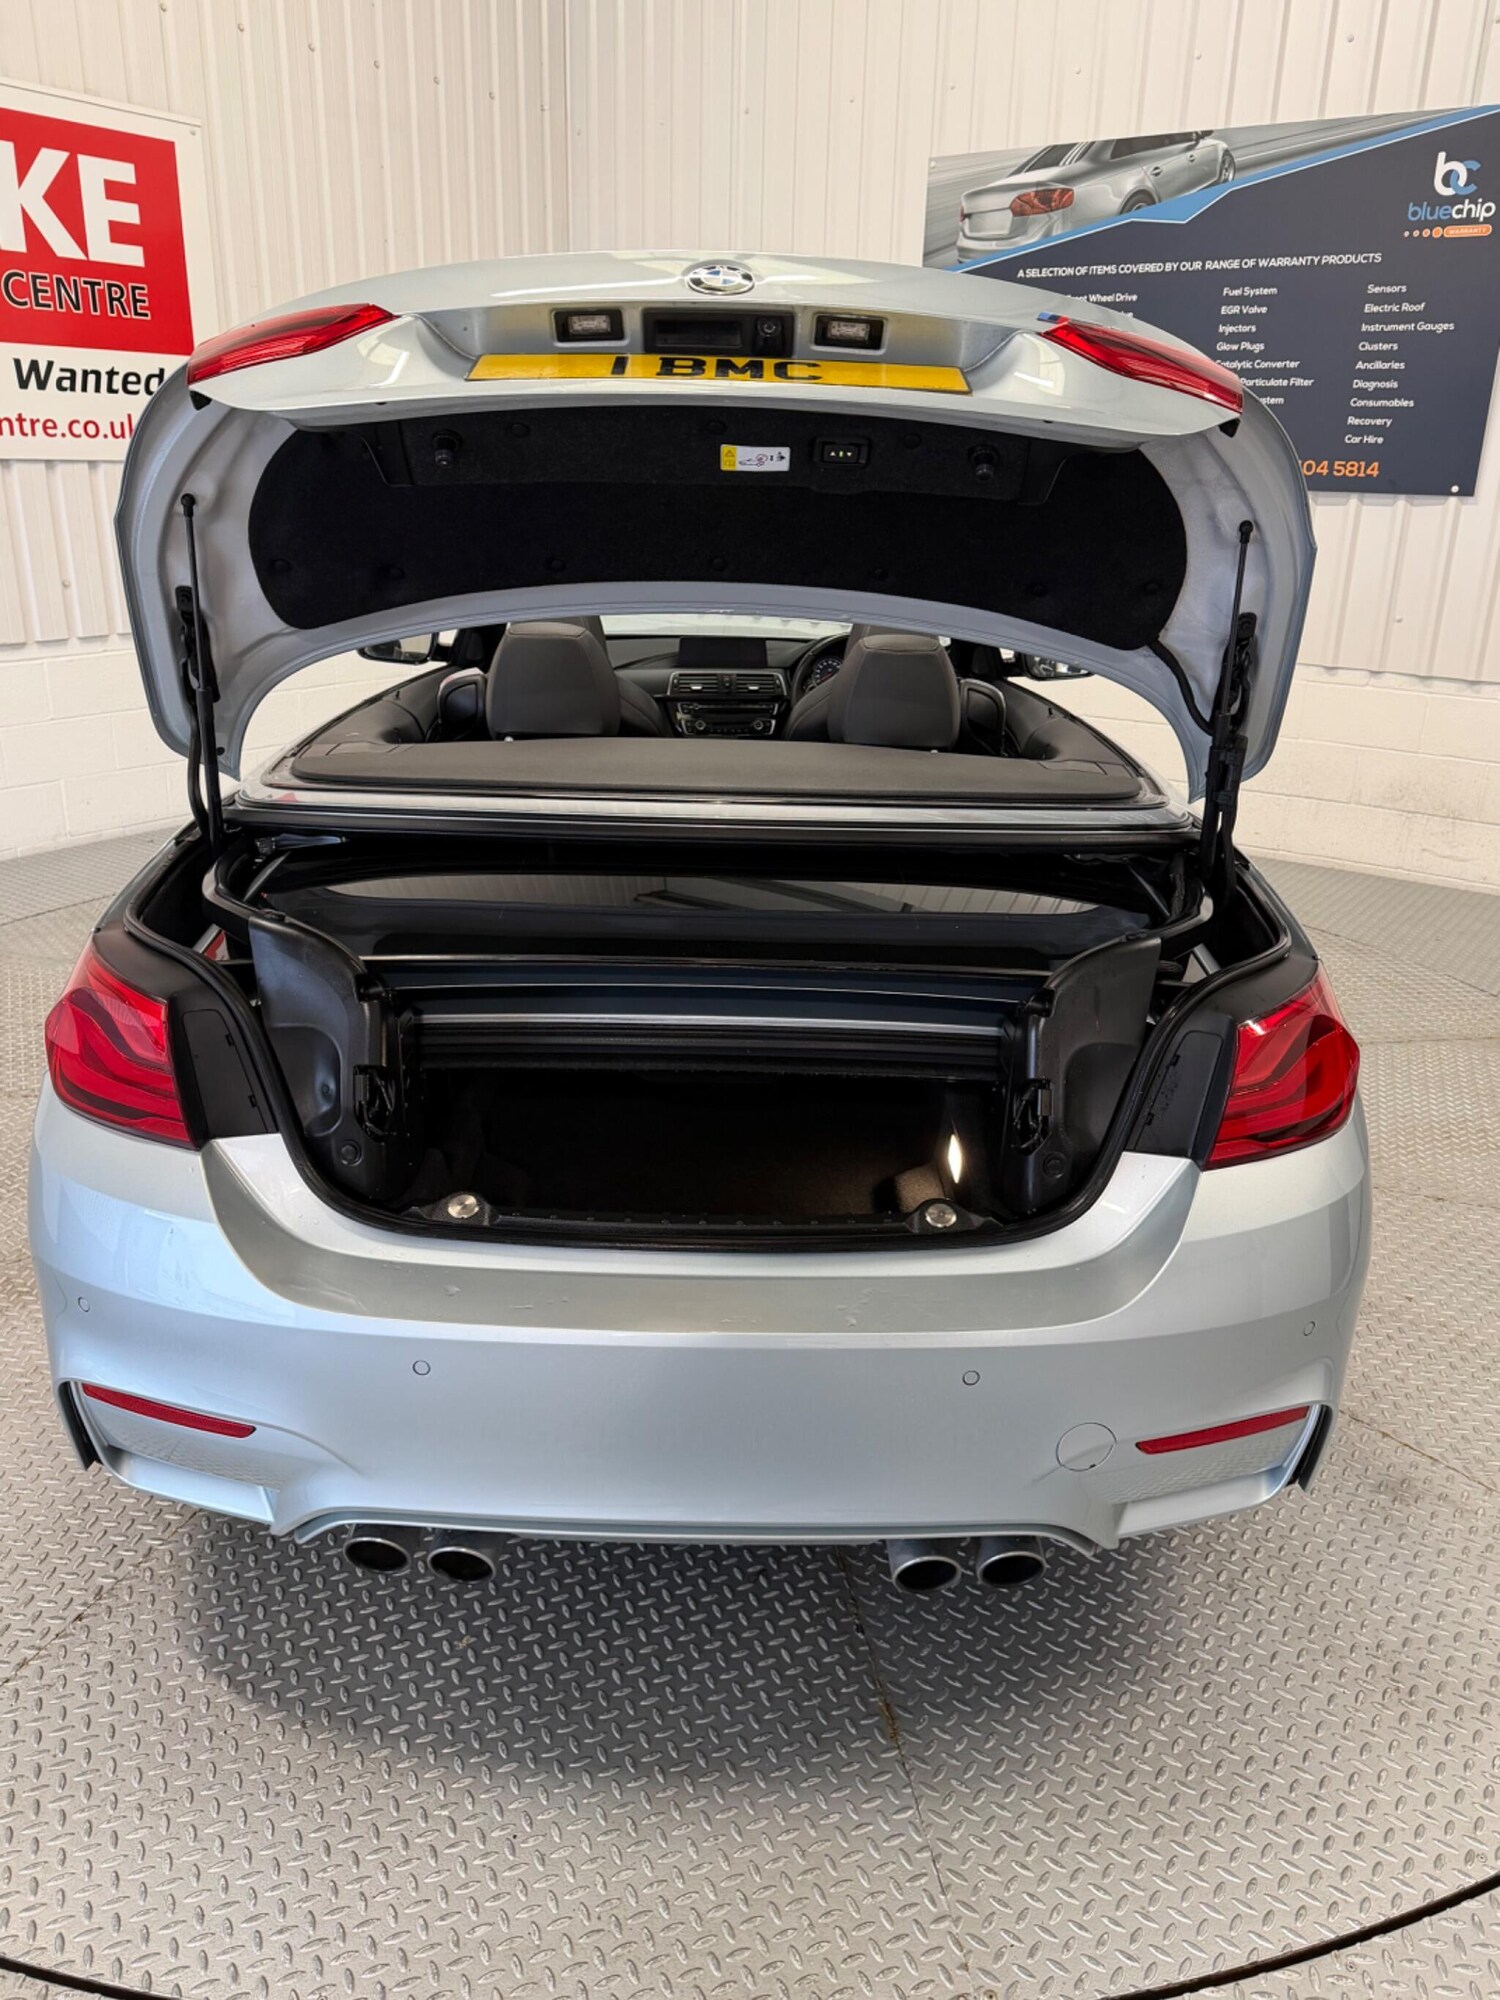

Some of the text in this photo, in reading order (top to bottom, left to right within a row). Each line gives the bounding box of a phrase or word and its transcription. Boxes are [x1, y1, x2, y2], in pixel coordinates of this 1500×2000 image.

[1408, 198, 1496, 222] bluechip
[1017, 253, 1382, 278] A SELECTION OF ITEMS COVERED BY OUR RANGE OF WARRANTY PRODUCTS
[1222, 286, 1278, 298] Fuel System
[1367, 284, 1407, 294] Sensors
[2, 271, 151, 320] CENTRE
[1088, 294, 1115, 302] Wheel
[1115, 292, 1138, 302] Drive
[1220, 304, 1268, 315] EGR Valve
[1364, 302, 1426, 313] Electric Roof
[1218, 323, 1256, 335] Injectors
[1361, 321, 1455, 334] Instrument Gauges
[1216, 341, 1265, 353] Glow Plugs
[1358, 341, 1399, 351] Clusters
[656, 356, 823, 381] BMC
[1254, 359, 1300, 369] Converter
[1355, 360, 1405, 370] Ancillaries
[13, 357, 165, 396] Wanted
[1240, 377, 1314, 387] Particulate Filter
[1352, 379, 1398, 391] Diagnosis
[1350, 398, 1415, 408] Consumables
[1347, 416, 1392, 428] Recovery
[1344, 434, 1384, 444] Car Hire
[1299, 460, 1379, 477] 04 5814
